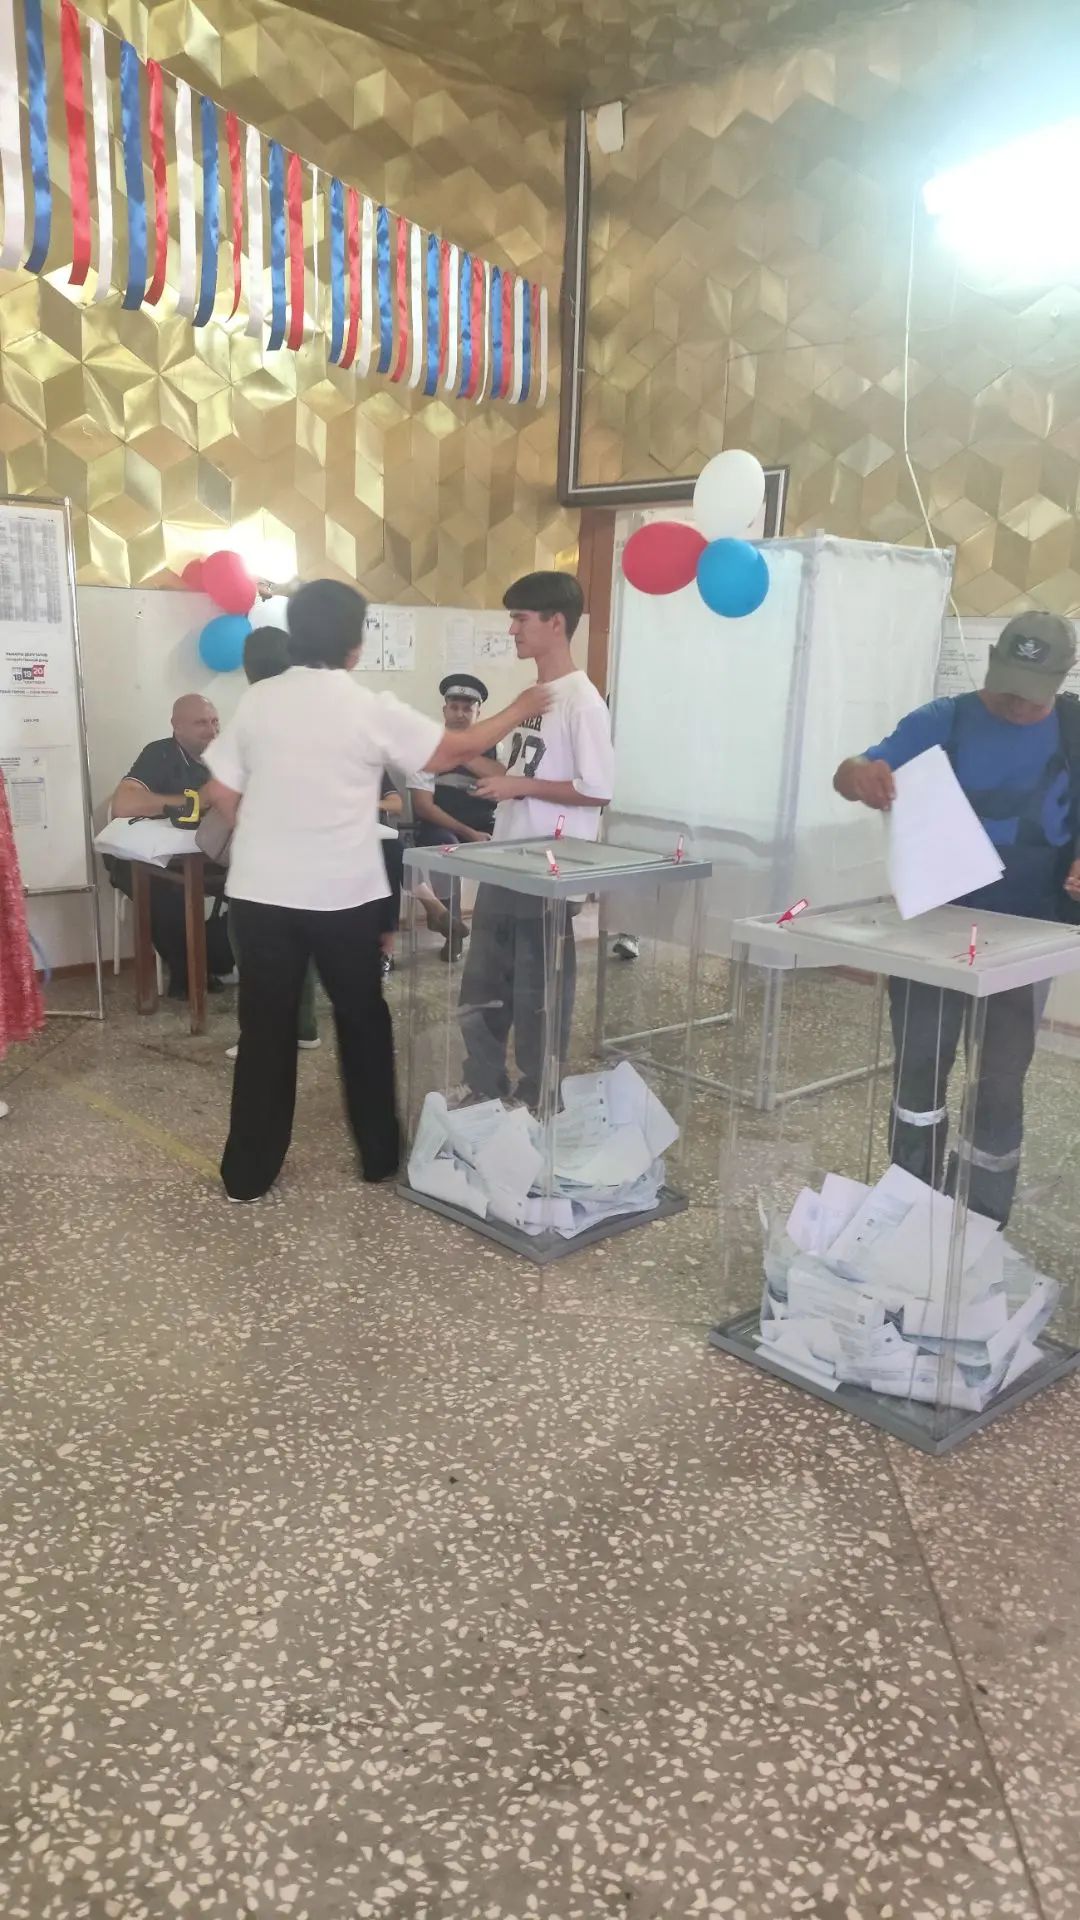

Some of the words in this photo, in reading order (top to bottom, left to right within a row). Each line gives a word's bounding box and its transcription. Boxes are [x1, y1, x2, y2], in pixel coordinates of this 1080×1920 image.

[13, 673, 22, 681] 18
[23, 670, 32, 678] 19
[33, 667, 43, 675] 20
